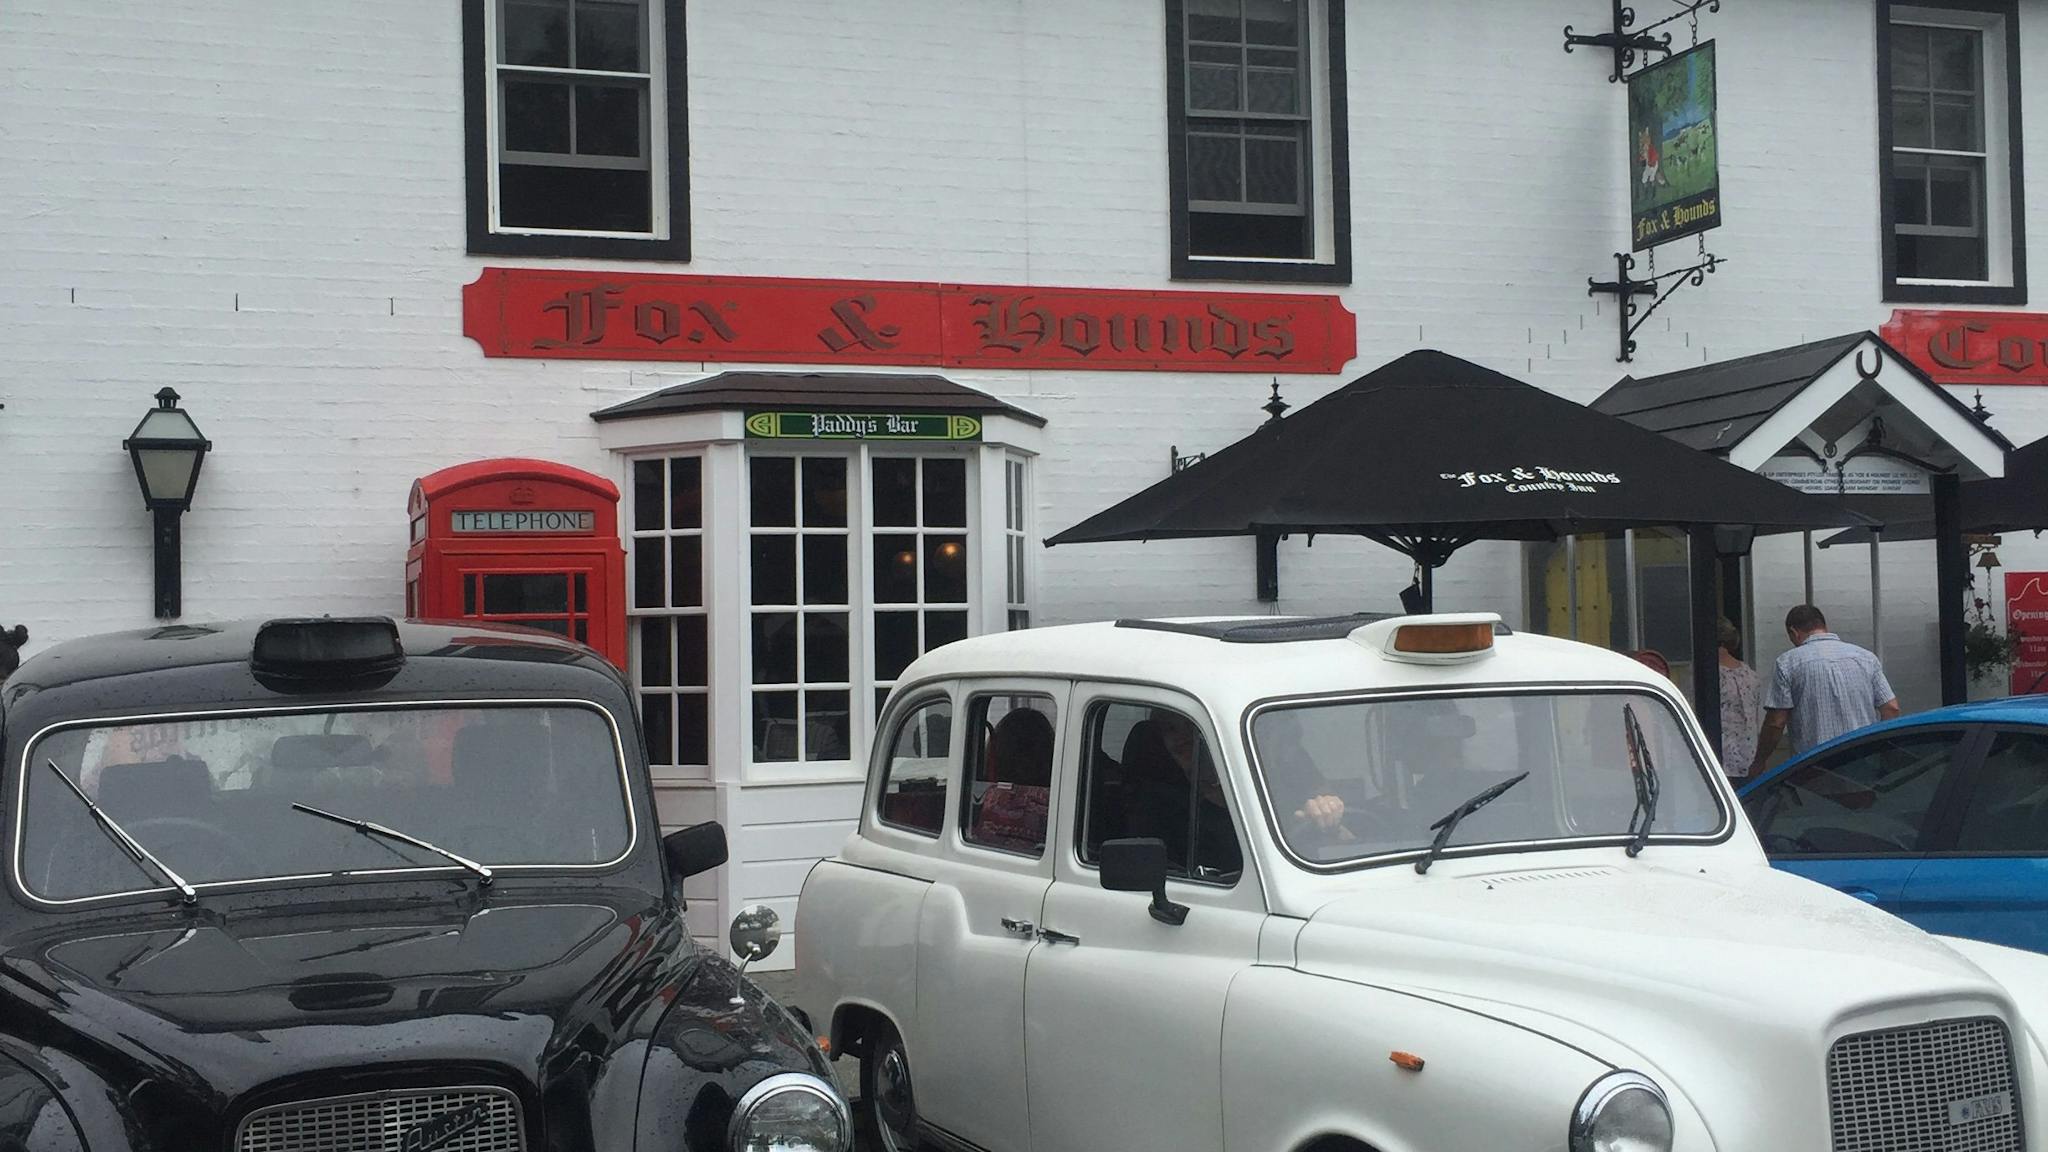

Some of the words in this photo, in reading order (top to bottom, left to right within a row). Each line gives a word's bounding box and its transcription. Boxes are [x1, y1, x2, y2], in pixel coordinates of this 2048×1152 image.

[1636, 217, 1658, 242] Fox
[1660, 210, 1671, 230] &
[1673, 197, 1716, 226] Hounds
[531, 283, 741, 350] Fox
[817, 296, 899, 353] &
[970, 295, 1296, 360] Hounds
[1927, 319, 2048, 373] Co
[811, 413, 878, 439] Paddy's
[886, 414, 919, 433] Bar
[1457, 472, 1507, 488] Fox
[1511, 467, 1536, 481] &
[1534, 466, 1620, 483] Hounds
[1505, 482, 1565, 493] Country
[1565, 482, 1597, 493] Inn
[455, 512, 590, 530] TELEPHONE
